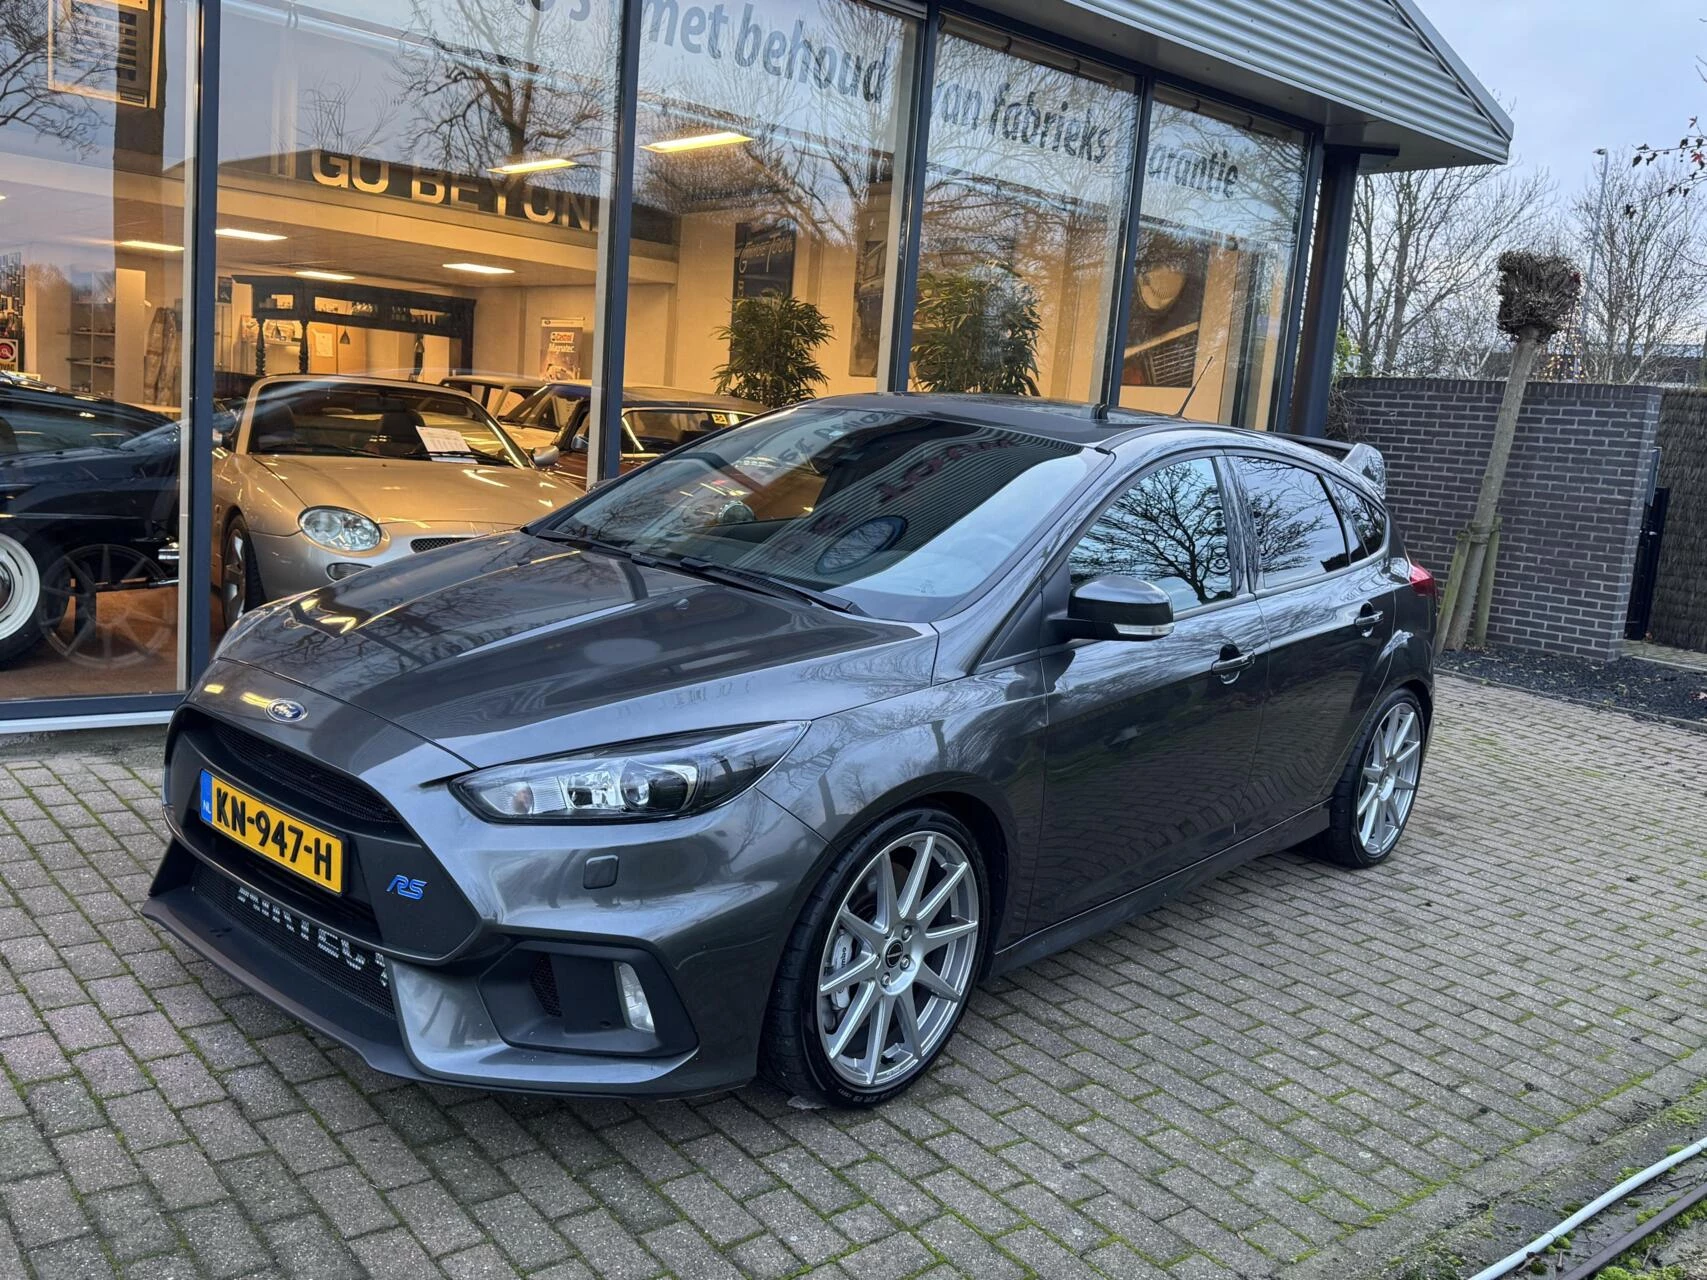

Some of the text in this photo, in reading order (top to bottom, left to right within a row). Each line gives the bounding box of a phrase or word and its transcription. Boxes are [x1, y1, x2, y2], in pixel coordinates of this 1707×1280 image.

[734, 3, 894, 104] behoud
[202, 800, 212, 814] NL
[216, 786, 332, 882] KN-947-H
[386, 874, 428, 900] RS
